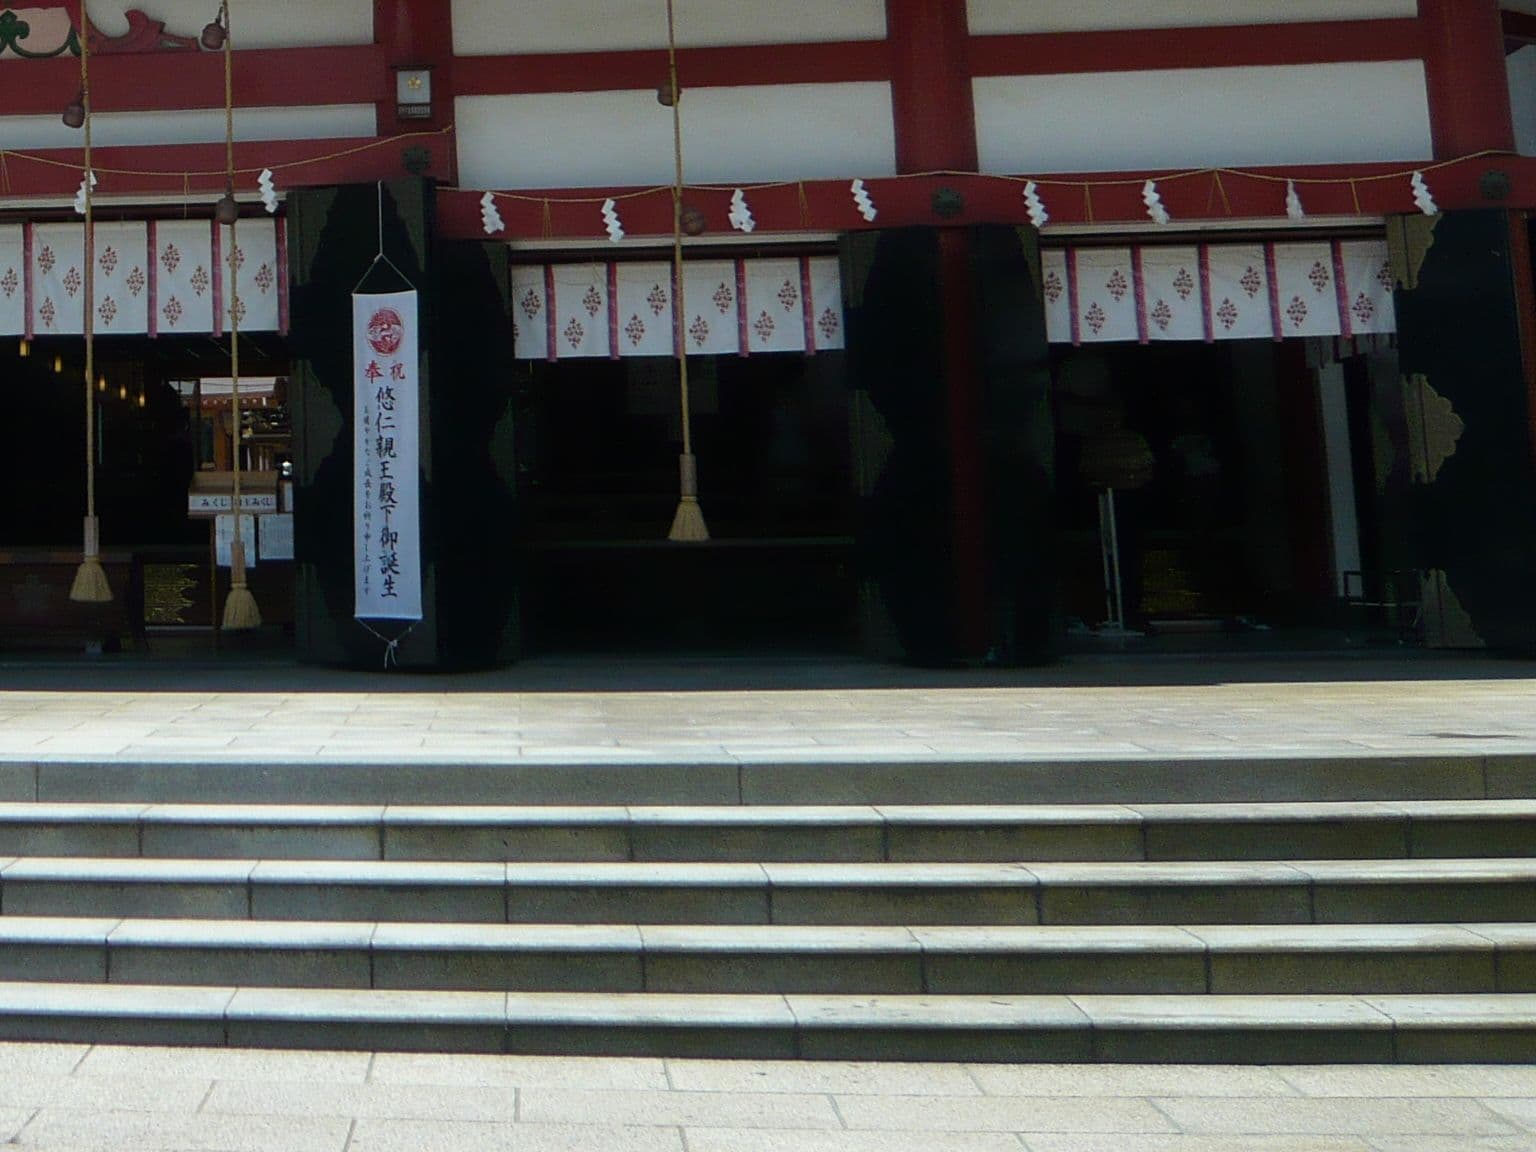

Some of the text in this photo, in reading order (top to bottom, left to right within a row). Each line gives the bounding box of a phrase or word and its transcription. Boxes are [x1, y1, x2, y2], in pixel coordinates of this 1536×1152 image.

[363, 359, 407, 384] 奉祝
[374, 386, 400, 600] 悠仁親王殿下御誕生
